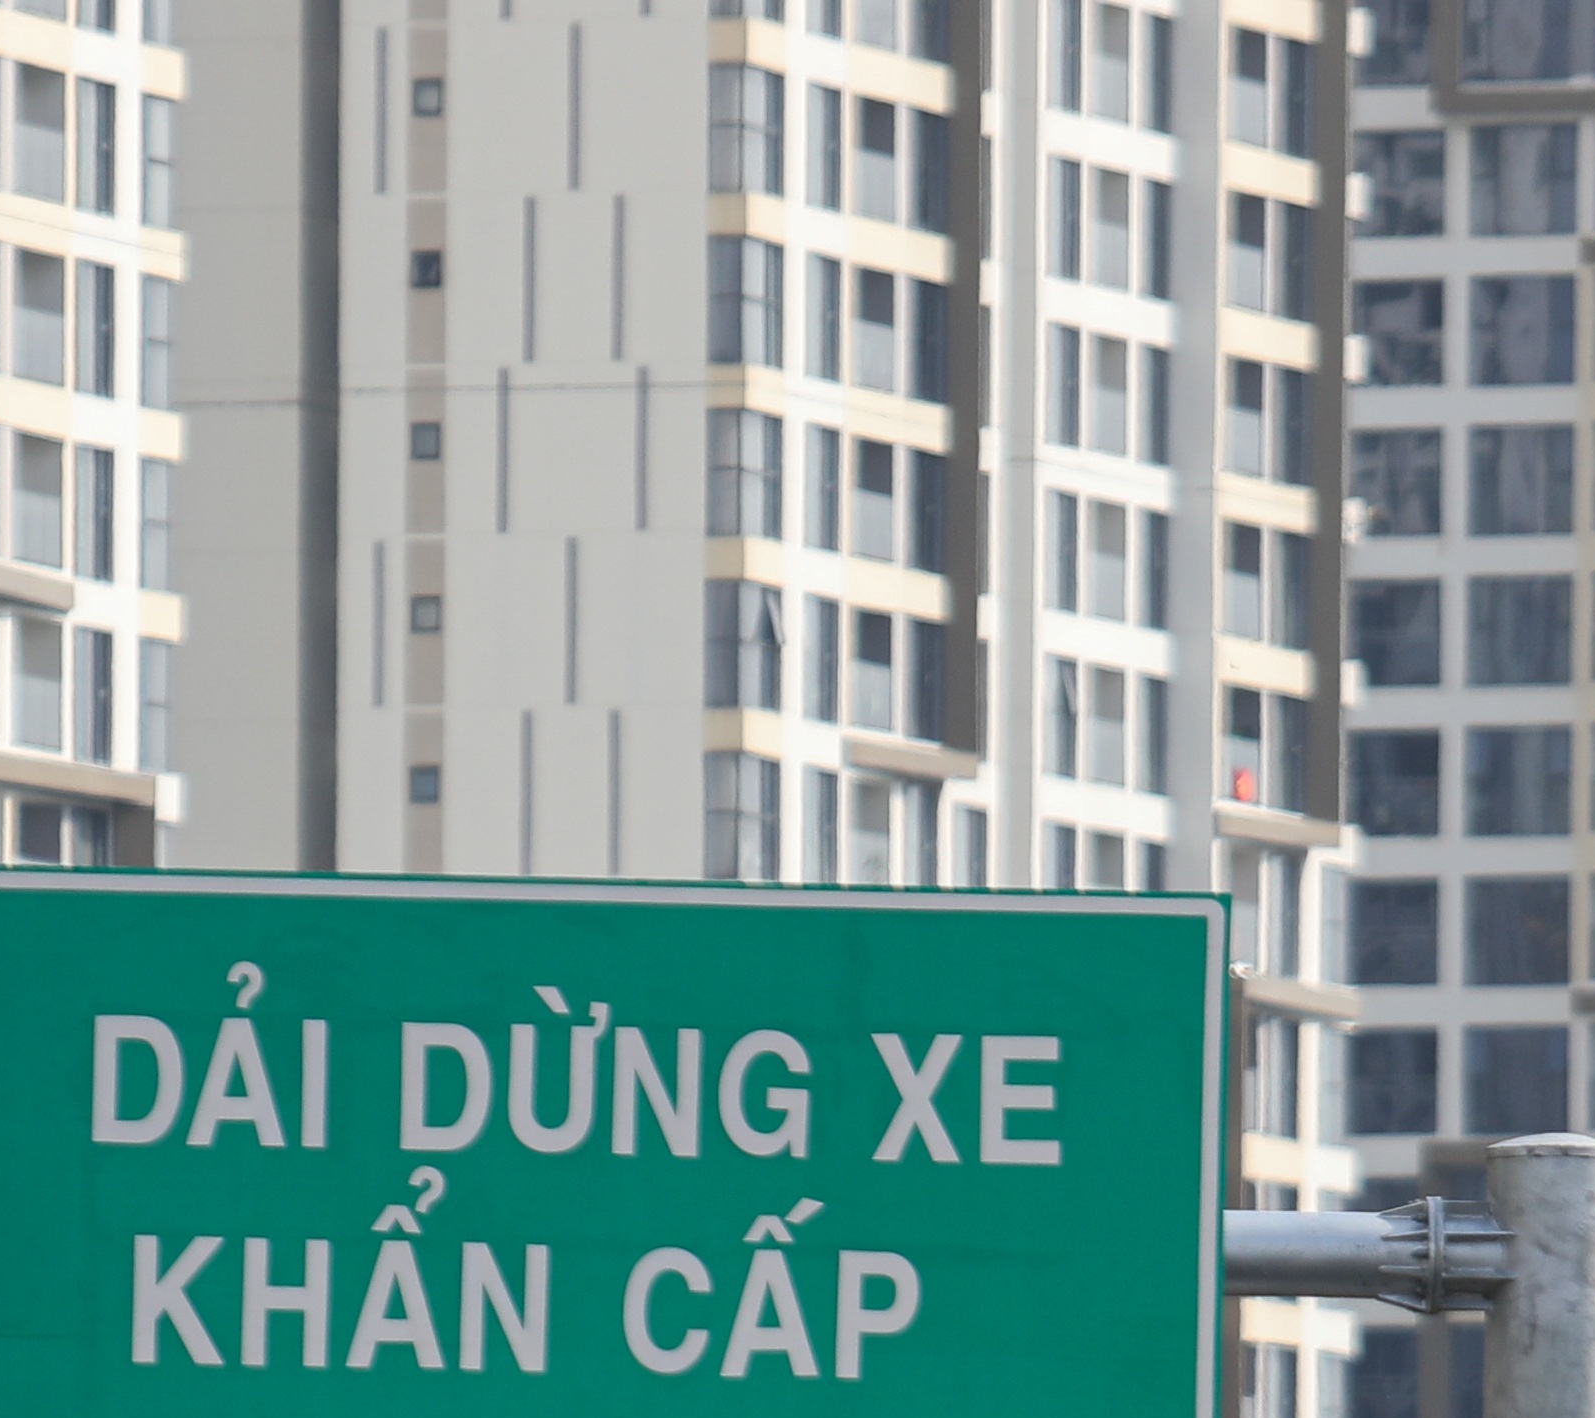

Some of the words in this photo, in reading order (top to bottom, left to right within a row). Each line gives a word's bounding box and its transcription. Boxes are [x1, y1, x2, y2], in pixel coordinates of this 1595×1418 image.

[92, 961, 327, 1148] DẢI
[401, 986, 810, 1159] DỪNG
[872, 1033, 1061, 1165] XE
[132, 1166, 548, 1373] KHẨN
[624, 1198, 920, 1378] CẤP
